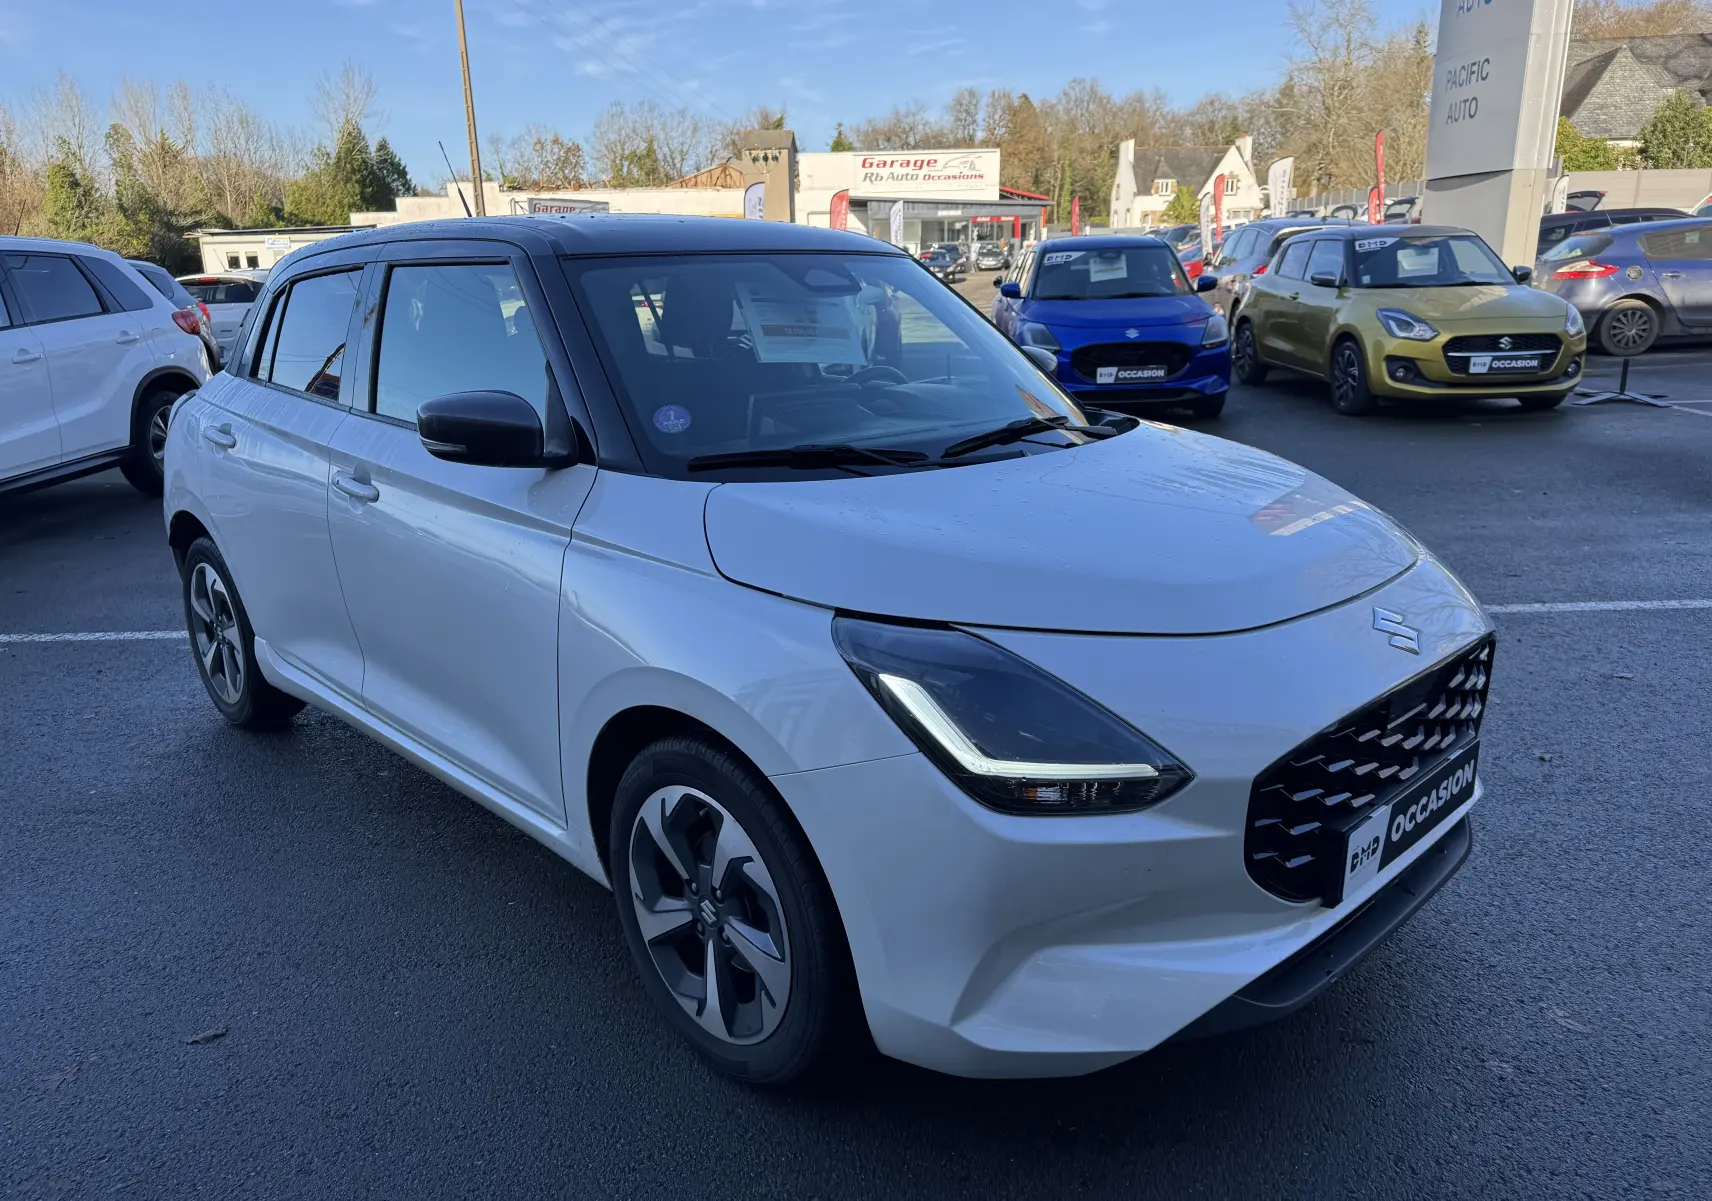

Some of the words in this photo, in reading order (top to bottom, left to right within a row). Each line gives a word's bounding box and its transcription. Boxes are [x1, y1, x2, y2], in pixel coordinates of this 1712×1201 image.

[1446, 58, 1490, 93] PACIFIC
[1446, 97, 1478, 124] AUTO
[861, 157, 938, 171] Garage
[862, 172, 884, 184] Rb
[885, 172, 919, 182] Auto
[922, 171, 985, 181] Occasions
[1491, 360, 1538, 368] OCCASION
[1118, 369, 1164, 379] OCCASION
[1391, 759, 1475, 842] OCCASION
